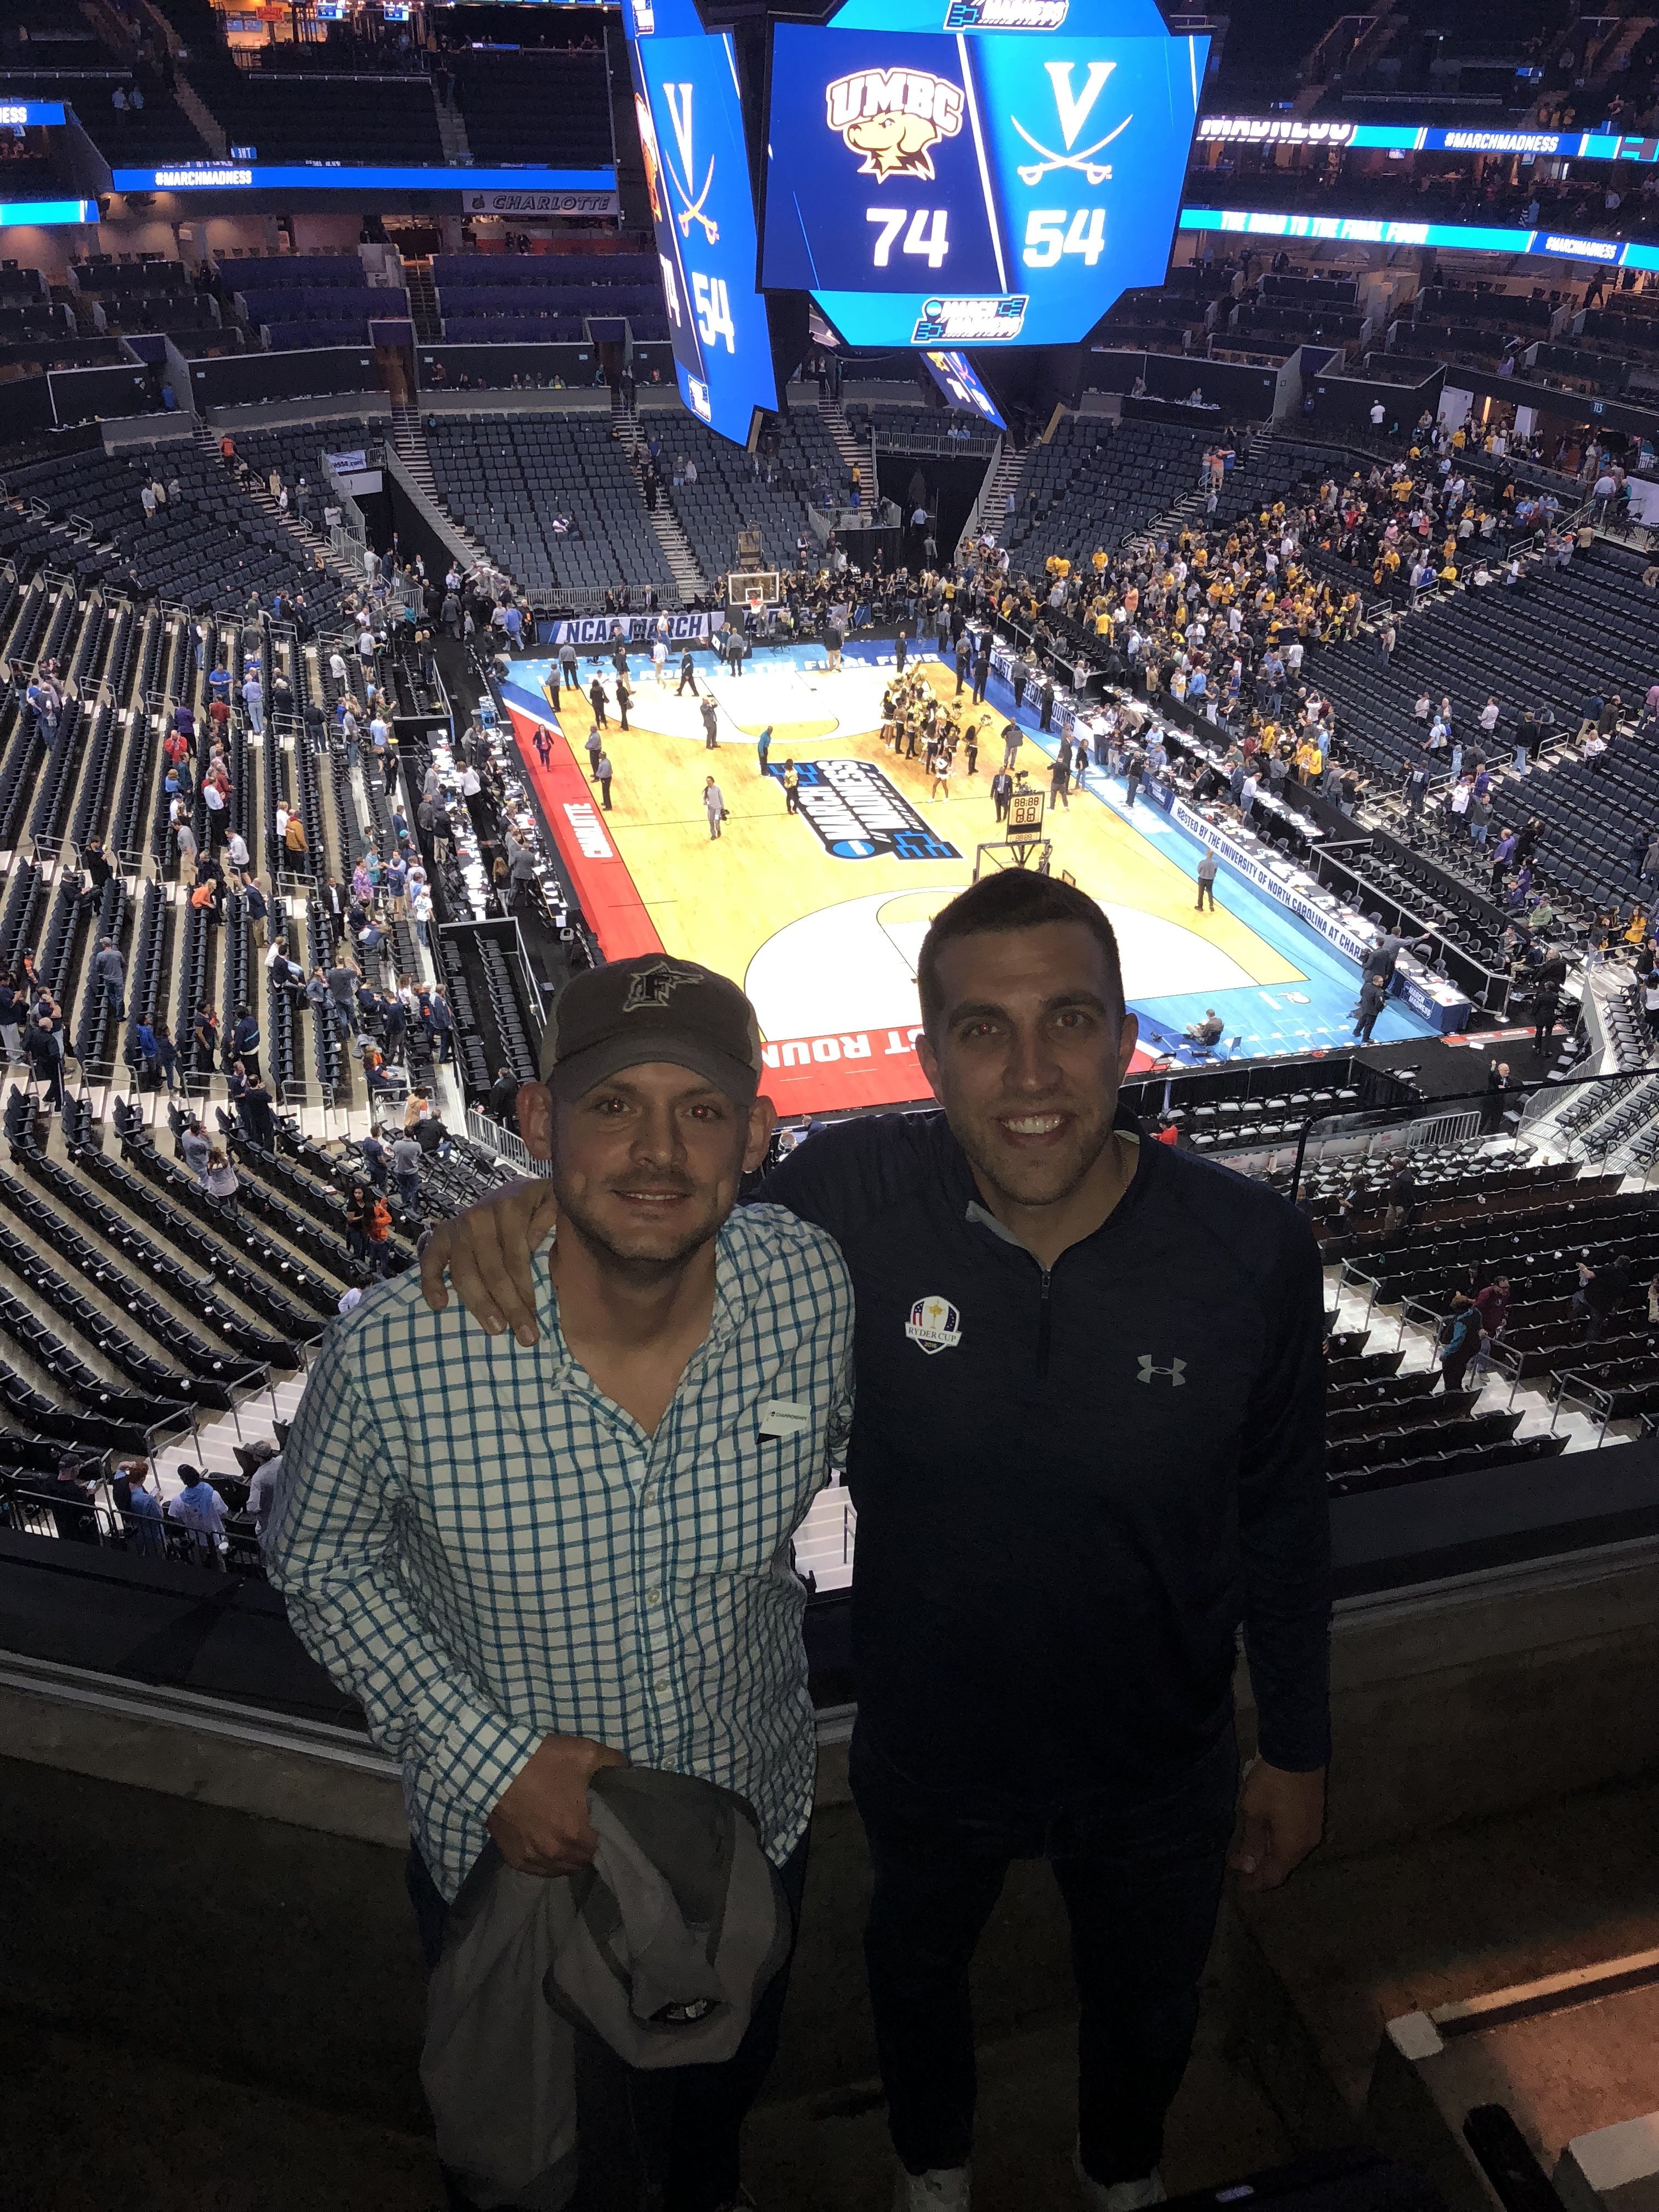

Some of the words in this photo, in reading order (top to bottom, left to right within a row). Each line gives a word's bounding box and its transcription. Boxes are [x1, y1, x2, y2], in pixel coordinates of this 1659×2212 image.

[827, 69, 963, 135] UMBC
[1045, 62, 1117, 151] V
[1444, 132, 1559, 152] #MARCHMADNESS
[155, 170, 252, 187] #MARCHMADNESS
[493, 195, 611, 211] CHARLOTTE
[866, 208, 949, 267] 74
[1023, 208, 1106, 268] 54
[1545, 236, 1617, 259] #MARCHMADNESS
[691, 272, 735, 354] 54
[566, 619, 619, 643] NCAA
[629, 615, 703, 641] MARCH
[994, 654, 1011, 680] FIRST
[1024, 685, 1042, 707] SECON
[1052, 702, 1076, 732] OUNDS
[816, 760, 911, 830] MADNESS
[798, 786, 871, 840] MARCH
[1177, 806, 1199, 832] HOSTED
[1199, 824, 1209, 839] BY
[1207, 831, 1221, 849] THE
[1220, 840, 1258, 878] UNIVERSITY
[1258, 871, 1267, 885] OF
[1267, 878, 1291, 906] NORTH
[1292, 898, 1328, 934] CAROLINA
[1328, 926, 1340, 941] AT
[1408, 986, 1425, 1005] MARCH
[1408, 995, 1432, 1017] MADNESS
[761, 1034, 872, 1069] ROUN
[909, 1327, 937, 1339] RYDER
[938, 1333, 957, 1342] CUP
